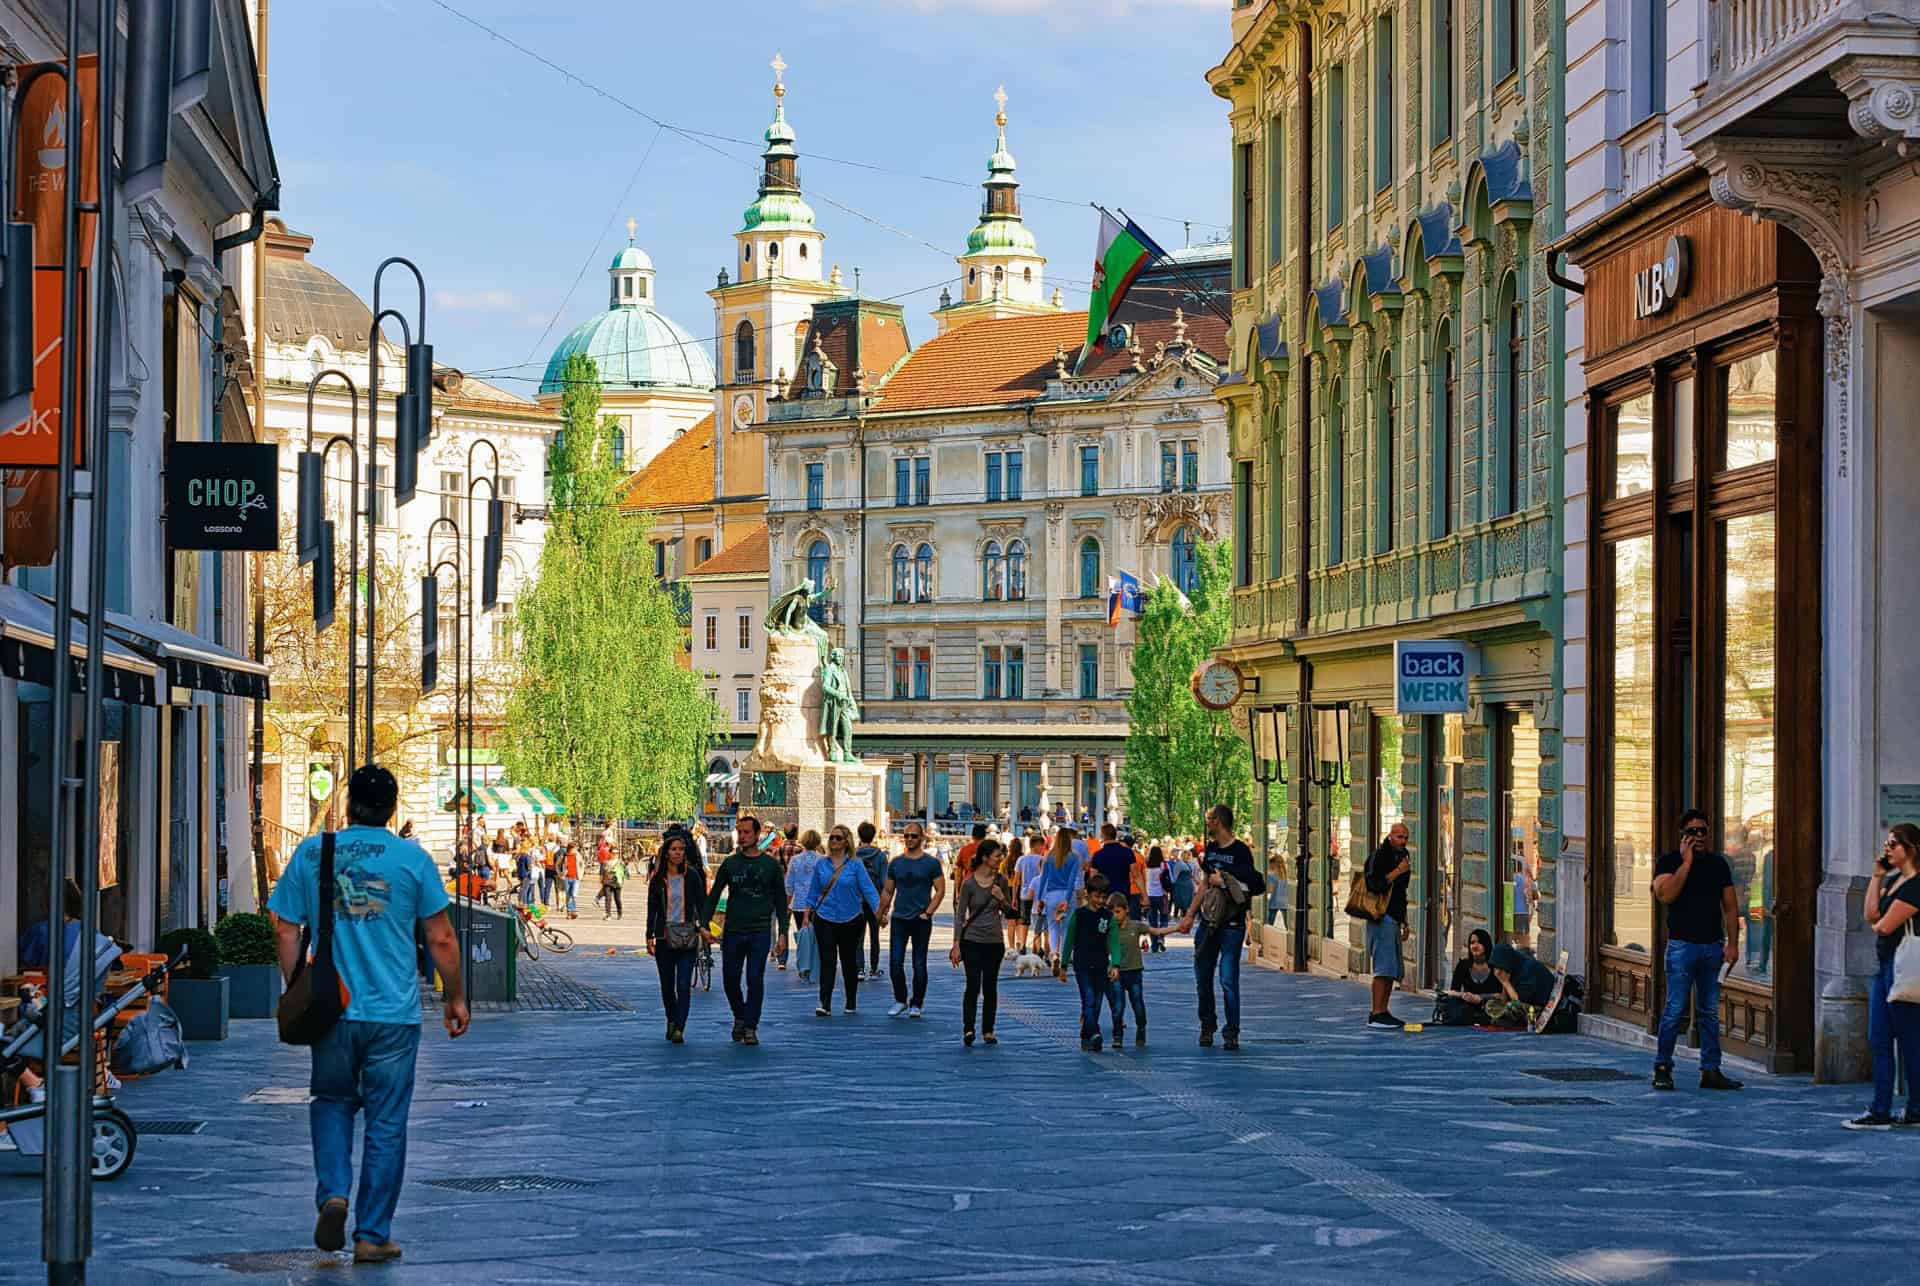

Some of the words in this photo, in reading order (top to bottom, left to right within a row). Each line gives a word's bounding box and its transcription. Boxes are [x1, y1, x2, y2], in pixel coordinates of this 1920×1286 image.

[28, 172, 49, 192] THE
[1635, 263, 1663, 320] NLB
[188, 478, 256, 507] CHOP
[1405, 654, 1461, 675] back
[1402, 681, 1464, 702] WERK
